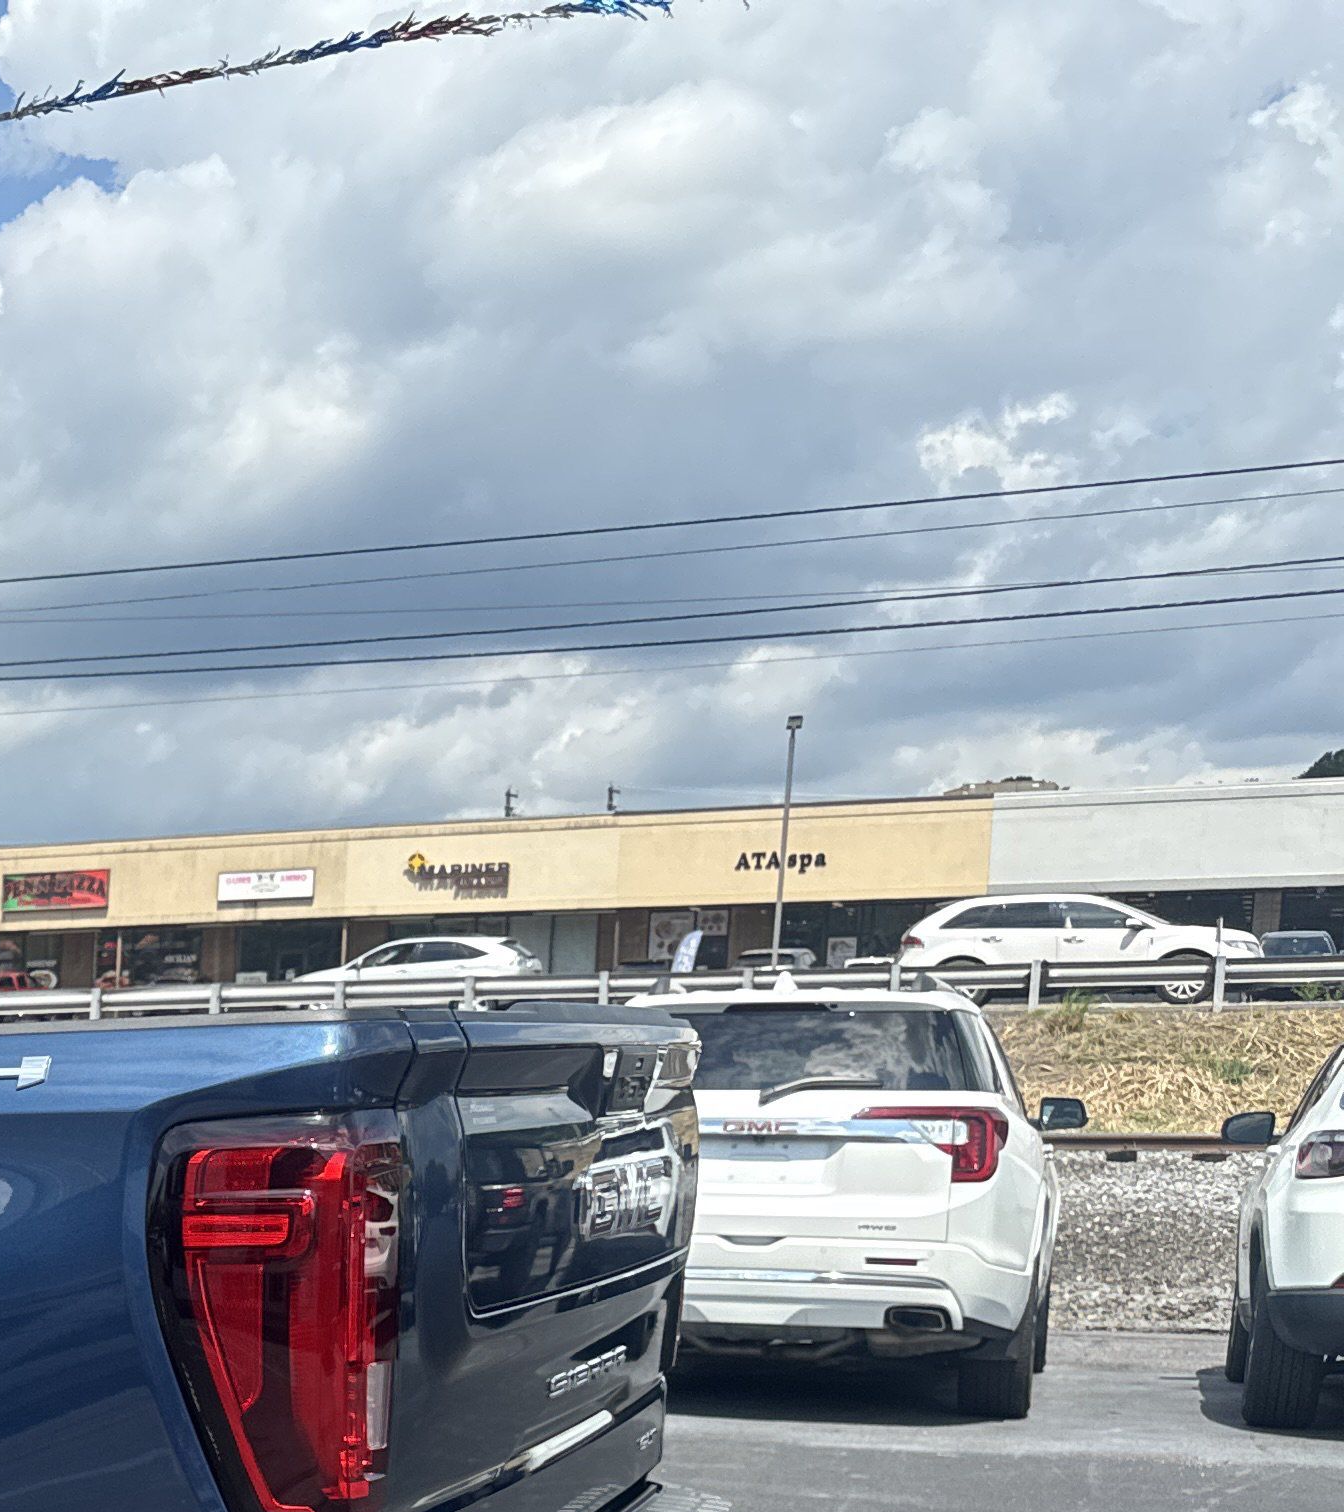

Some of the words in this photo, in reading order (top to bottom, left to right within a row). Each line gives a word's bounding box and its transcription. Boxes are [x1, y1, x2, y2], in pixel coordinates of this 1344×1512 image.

[417, 863, 510, 879] MARINER
[734, 851, 781, 871] ATA
[787, 853, 826, 874] spa
[723, 1120, 799, 1134] GMC
[549, 1344, 628, 1399] SIERRA
